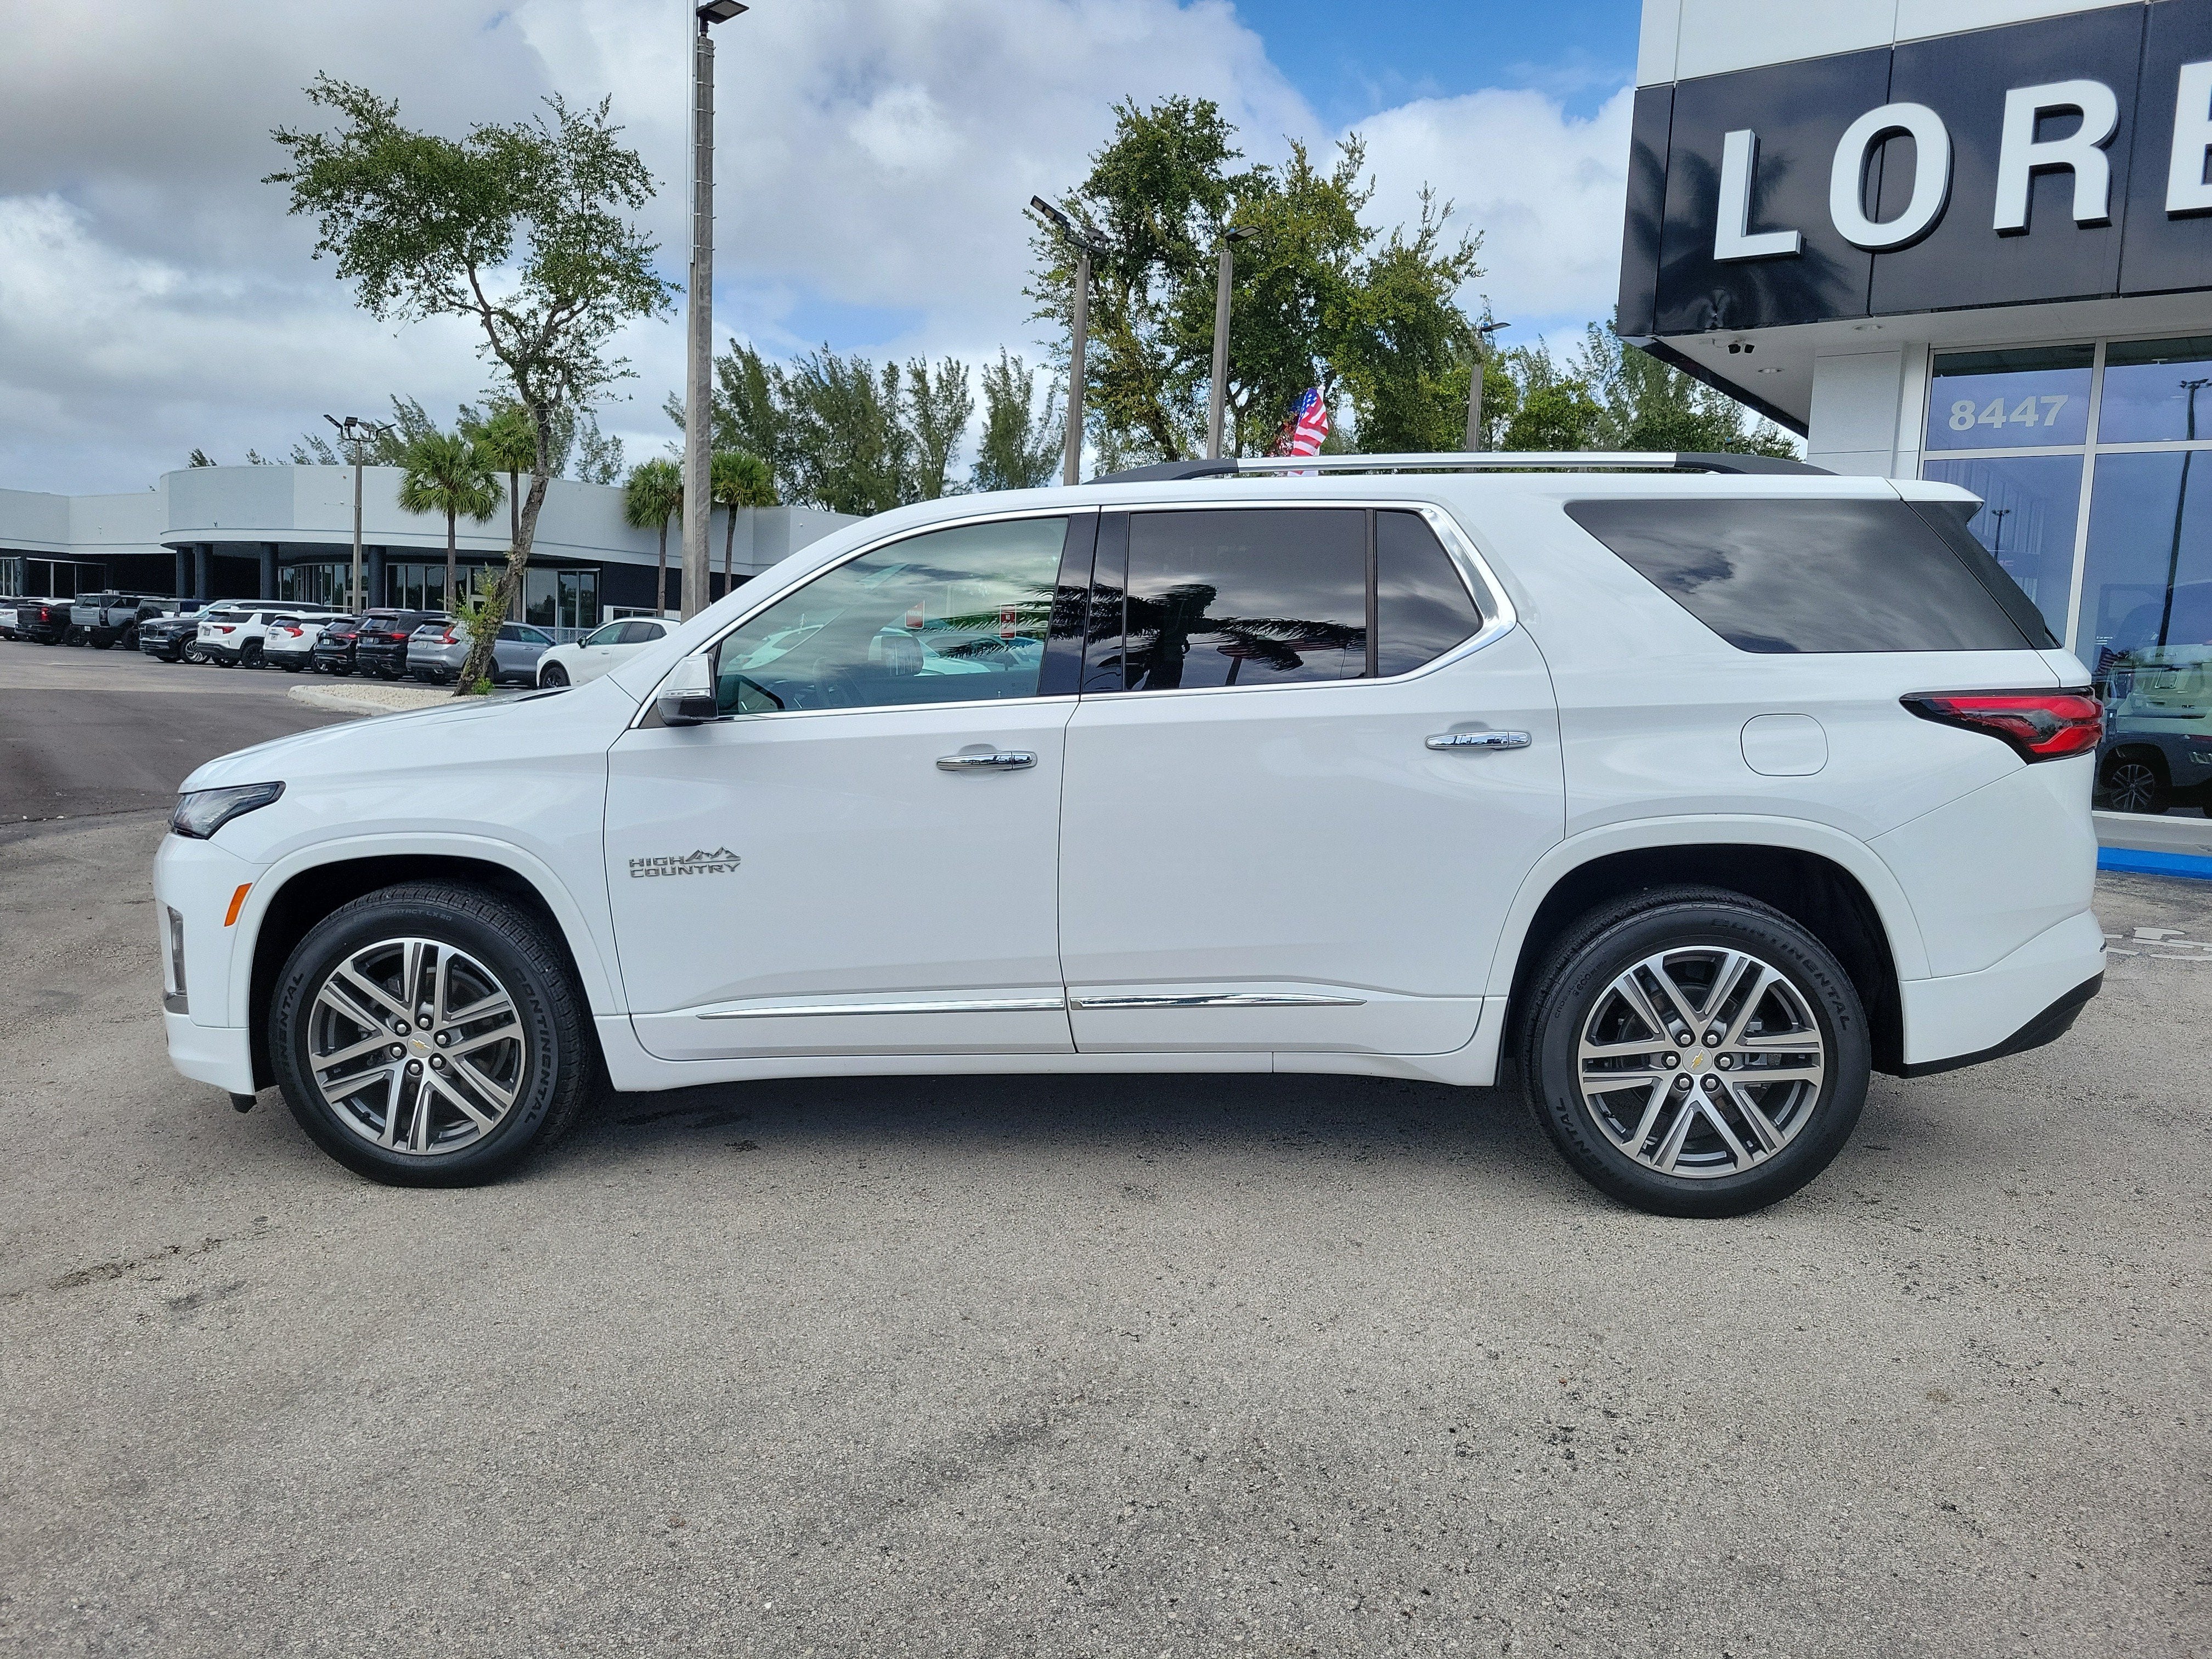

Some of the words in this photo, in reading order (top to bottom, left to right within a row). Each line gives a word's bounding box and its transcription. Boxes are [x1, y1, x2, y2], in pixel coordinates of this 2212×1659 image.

[1949, 395, 2069, 431] 8447
[629, 855, 686, 867] HIGH
[630, 862, 741, 878] COUNTRY
[1710, 918, 1849, 1031] CONTINENTAL
[513, 967, 551, 1124] CONTINENTAL
